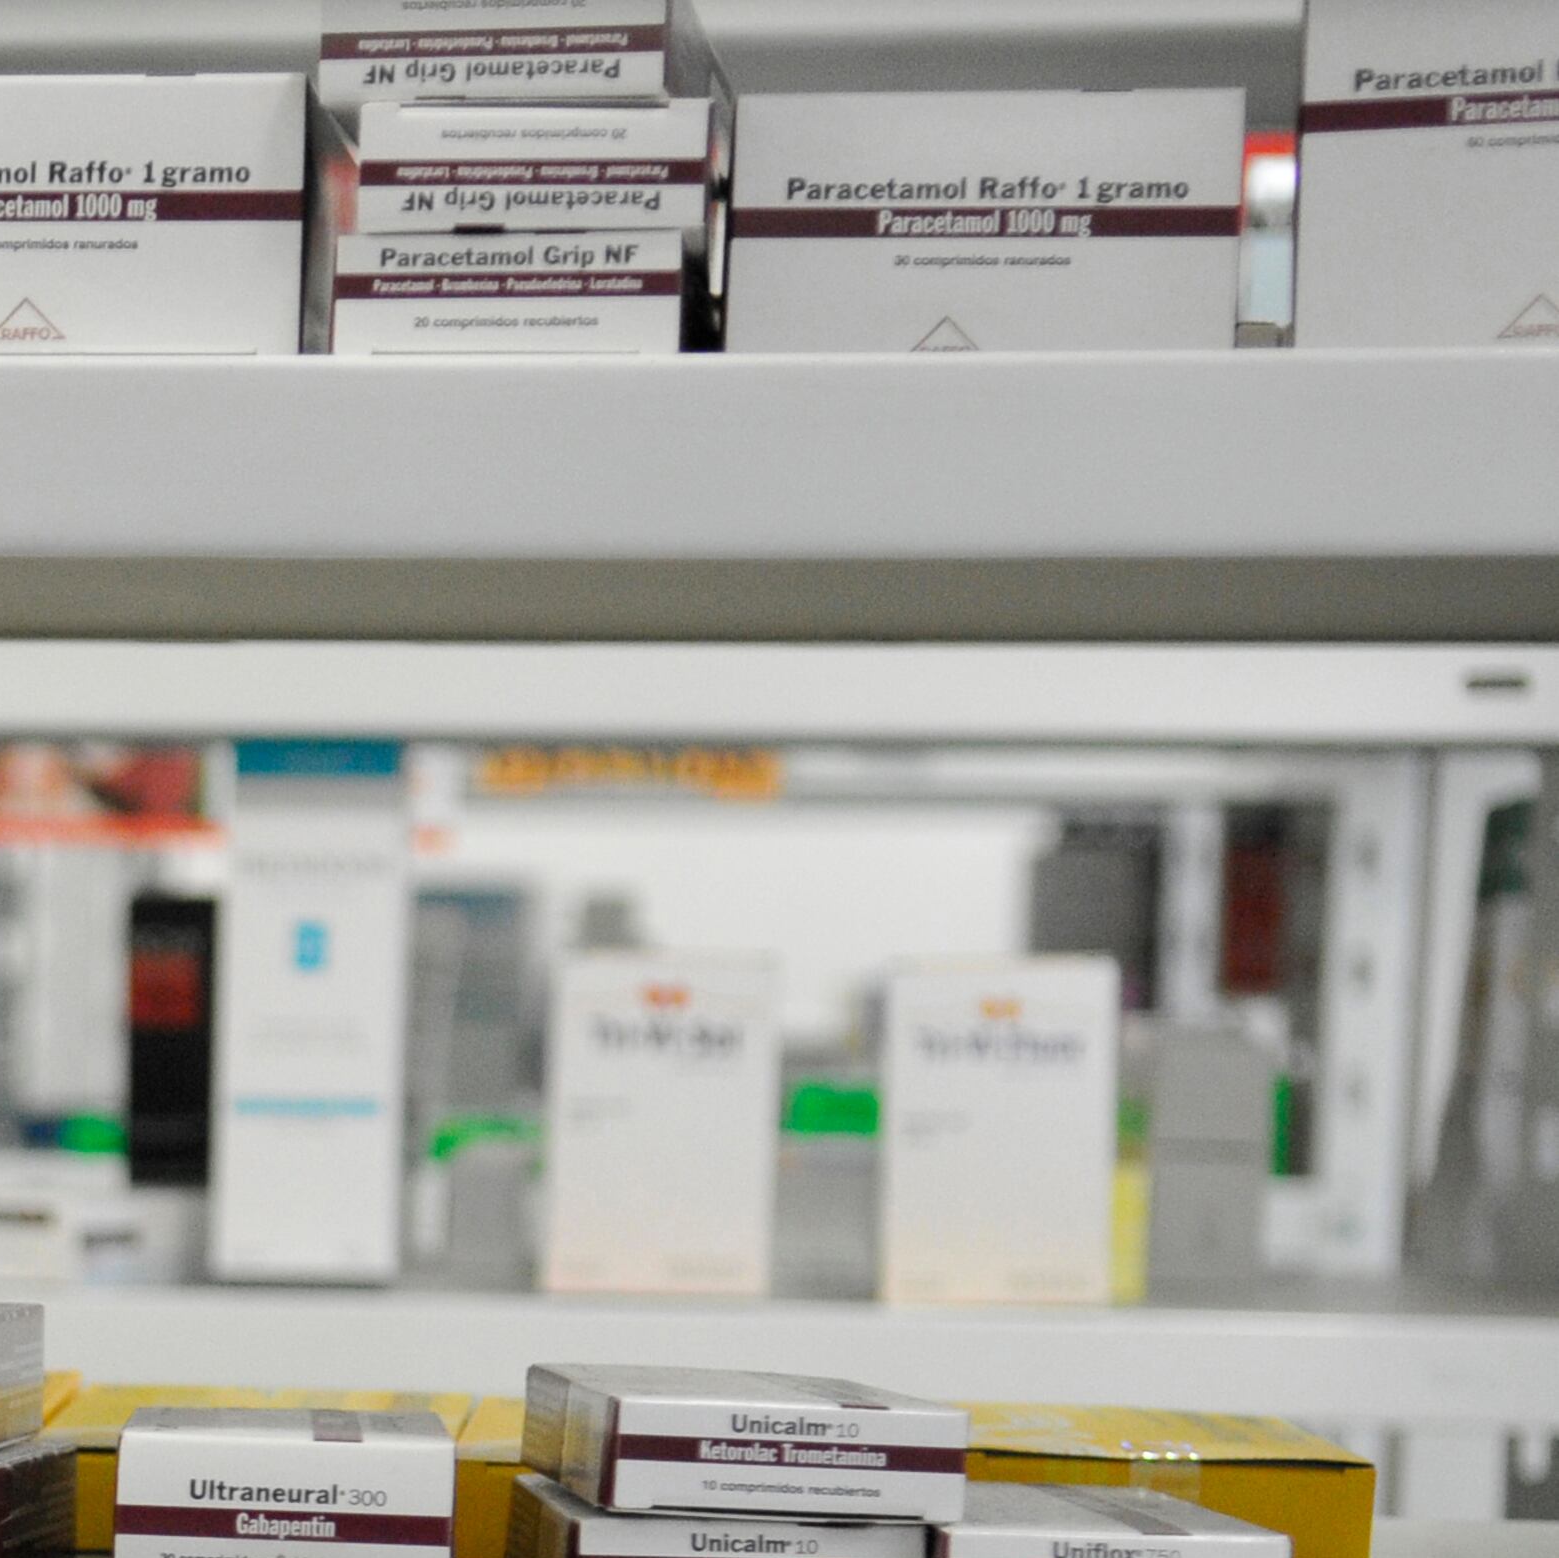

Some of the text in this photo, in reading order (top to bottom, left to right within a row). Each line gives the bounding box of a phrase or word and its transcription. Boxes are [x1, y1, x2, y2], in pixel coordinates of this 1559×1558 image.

[1354, 60, 1543, 92] Paracetamol
[143, 162, 155, 182] 1
[161, 164, 250, 187] gramo
[402, 189, 661, 211] Paracetamol Grip NF
[787, 177, 966, 201] Paracetamol
[1077, 177, 1091, 199] 1
[1097, 181, 1189, 205] gramo
[75, 195, 121, 218] 1000
[128, 199, 157, 222] mg
[73, 239, 138, 250] ranurados
[381, 245, 638, 268] Paracetamol Grip NF
[1, 327, 51, 340] RAFFO
[433, 316, 519, 329] comprimidos
[837, 1422, 859, 1438] 10
[699, 1440, 887, 1467] Ketorolac Trometamina
[348, 1489, 387, 1508] 300
[236, 1512, 336, 1540] Gabapentin
[795, 1539, 818, 1555] 10
